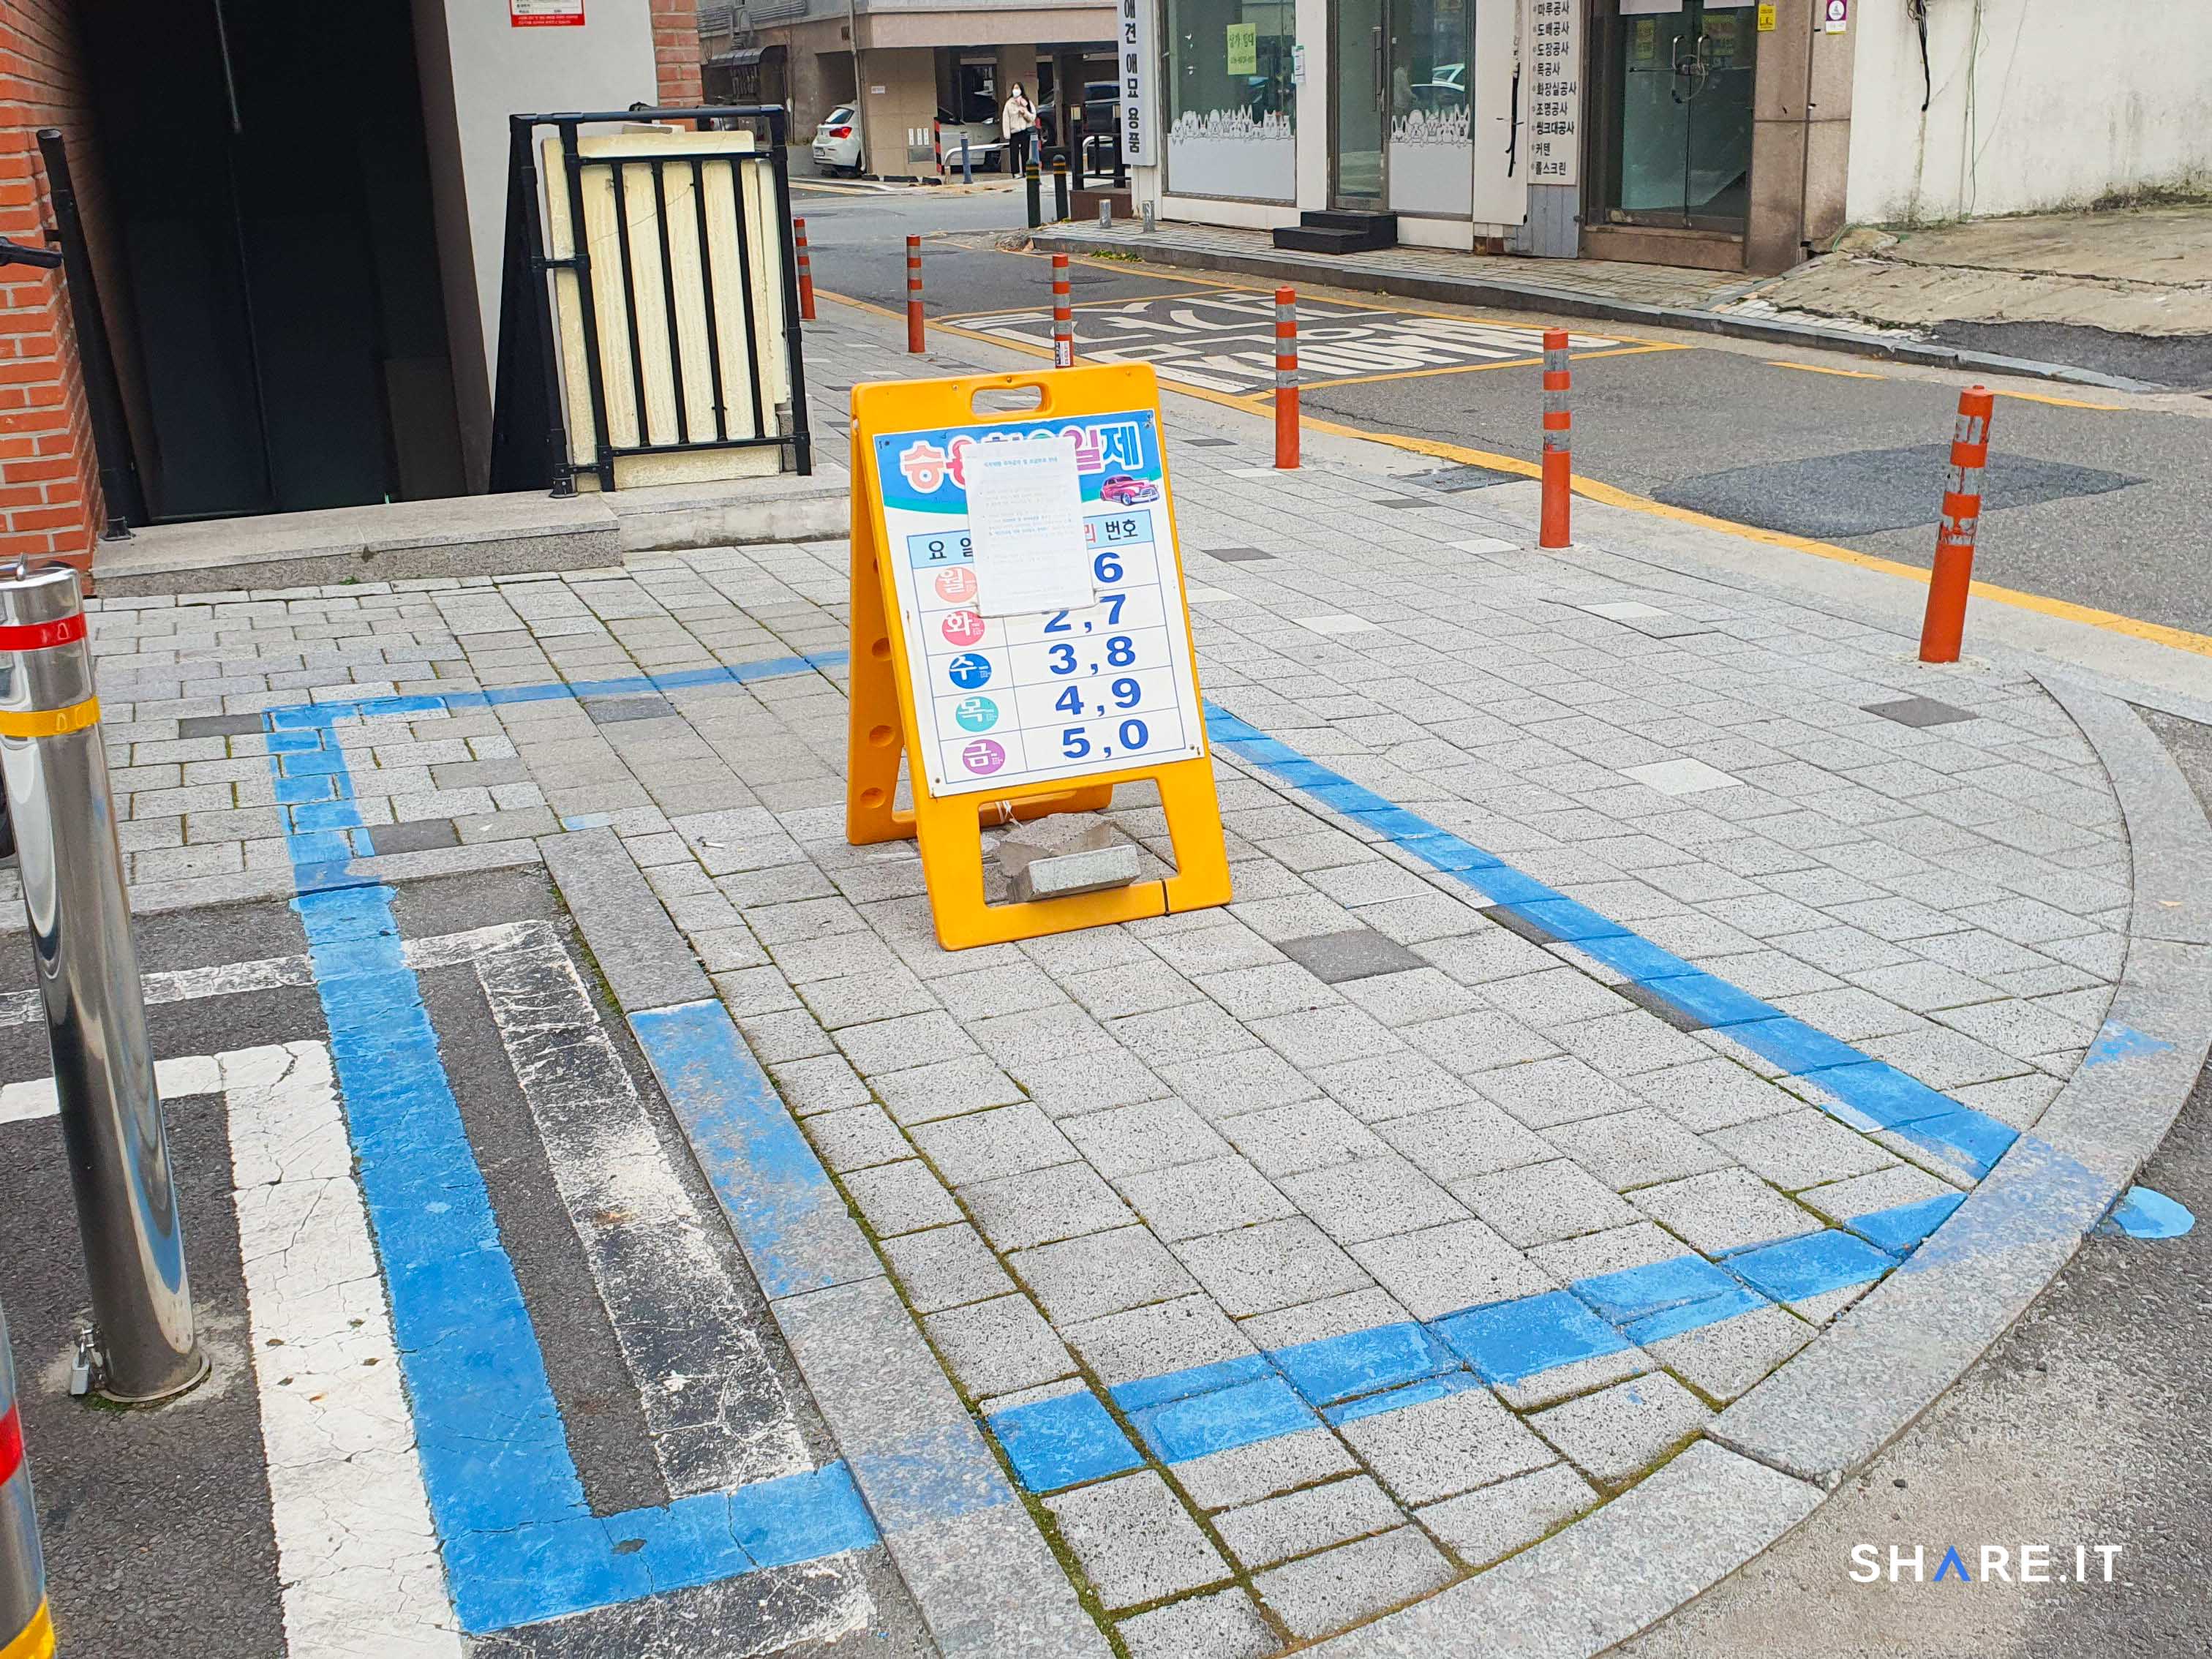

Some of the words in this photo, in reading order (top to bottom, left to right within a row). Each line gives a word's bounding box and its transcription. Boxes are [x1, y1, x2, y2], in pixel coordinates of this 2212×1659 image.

[1538, 0, 1570, 16] 마루공사
[1124, 0, 1137, 45] 애견
[1537, 42, 1569, 56] 도장공사
[1126, 53, 1139, 98] 애묘
[1537, 61, 1560, 76] 목공사
[1537, 81, 1577, 97] 화장실공사
[1536, 101, 1568, 116] 조명공사
[1127, 108, 1140, 154] 용품
[1537, 121, 1575, 135] 씽크대공사
[1536, 161, 1566, 176] 롤스크린
[1105, 519, 1139, 541] 번호
[938, 568, 966, 594] 월
[943, 612, 973, 636] 화
[949, 655, 978, 681] 수
[958, 699, 985, 723] 목
[963, 742, 992, 768] 금
